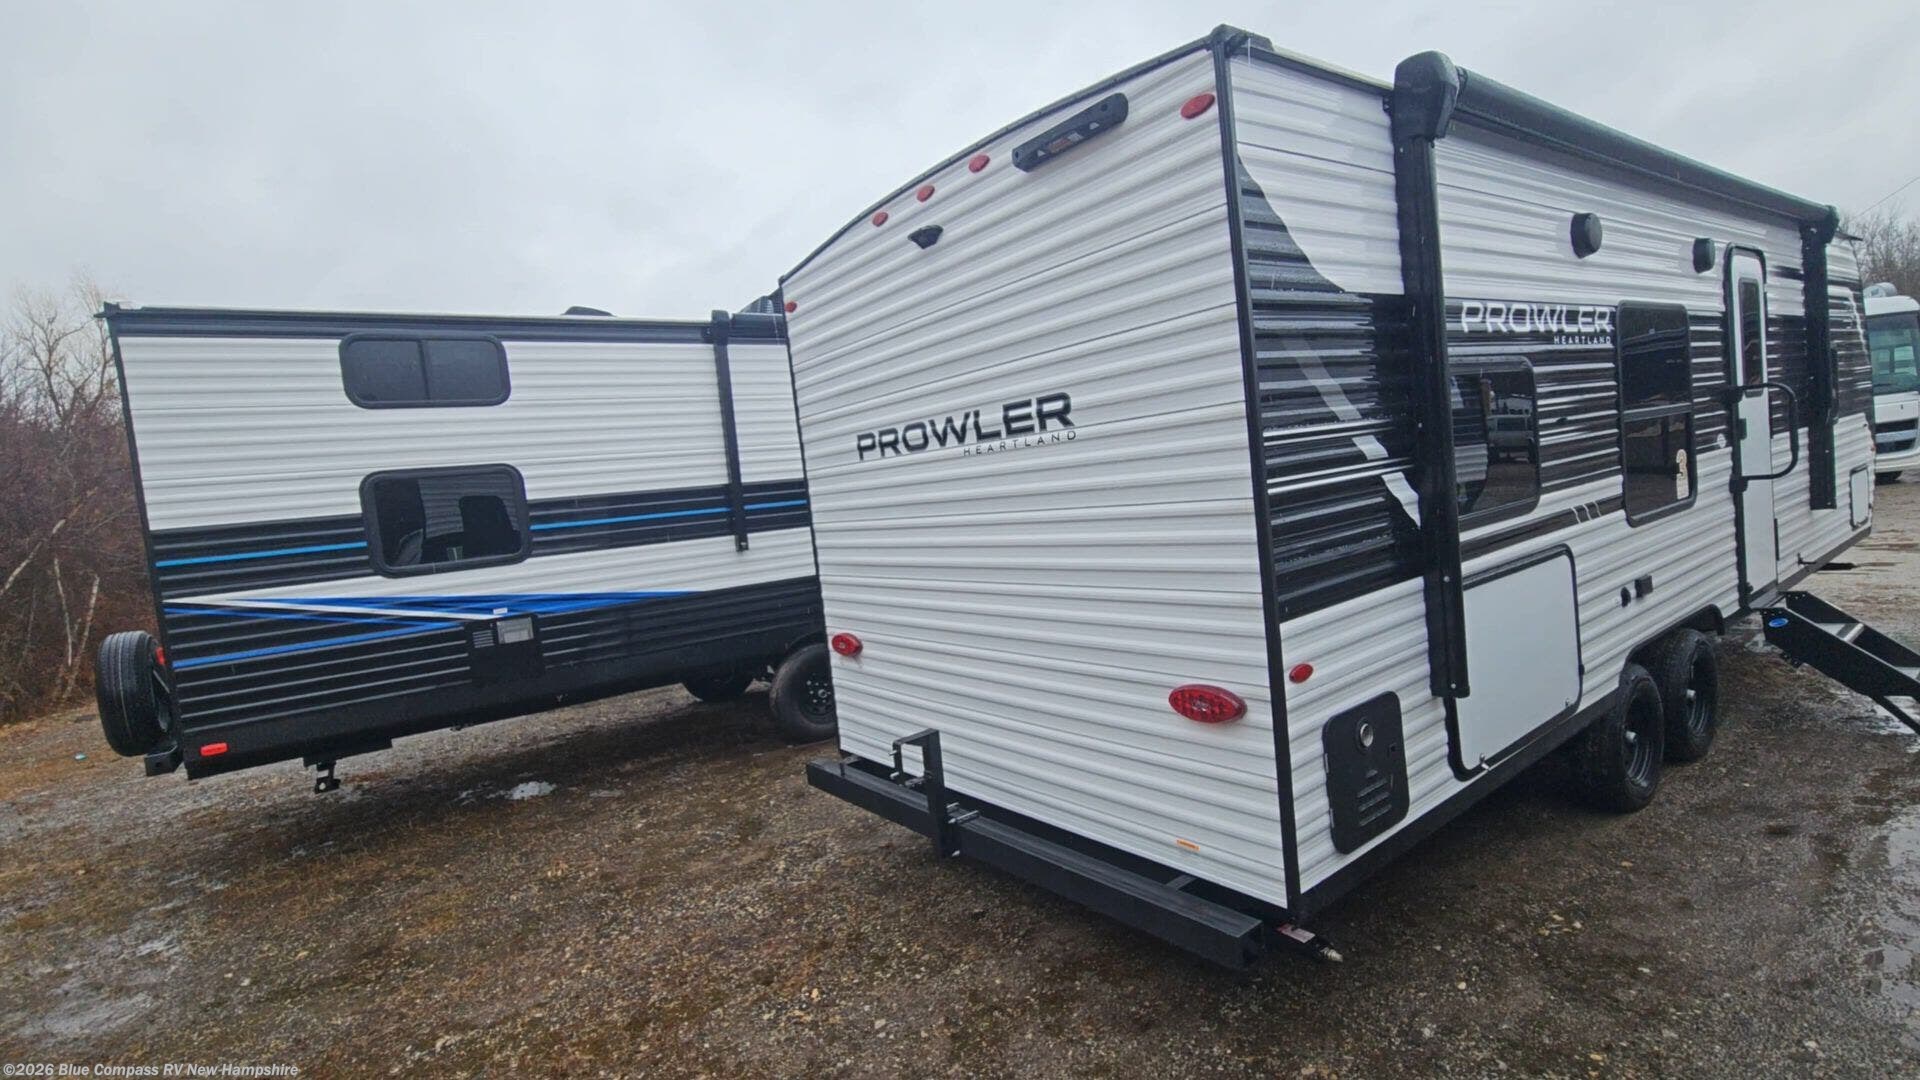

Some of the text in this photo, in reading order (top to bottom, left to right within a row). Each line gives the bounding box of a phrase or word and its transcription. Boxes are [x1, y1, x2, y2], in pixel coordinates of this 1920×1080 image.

[1461, 301, 1616, 333] PROWLER
[1553, 335, 1612, 345] HEARTLAND
[856, 391, 1075, 461] PROWLER
[963, 430, 1077, 457] HEARTLAND
